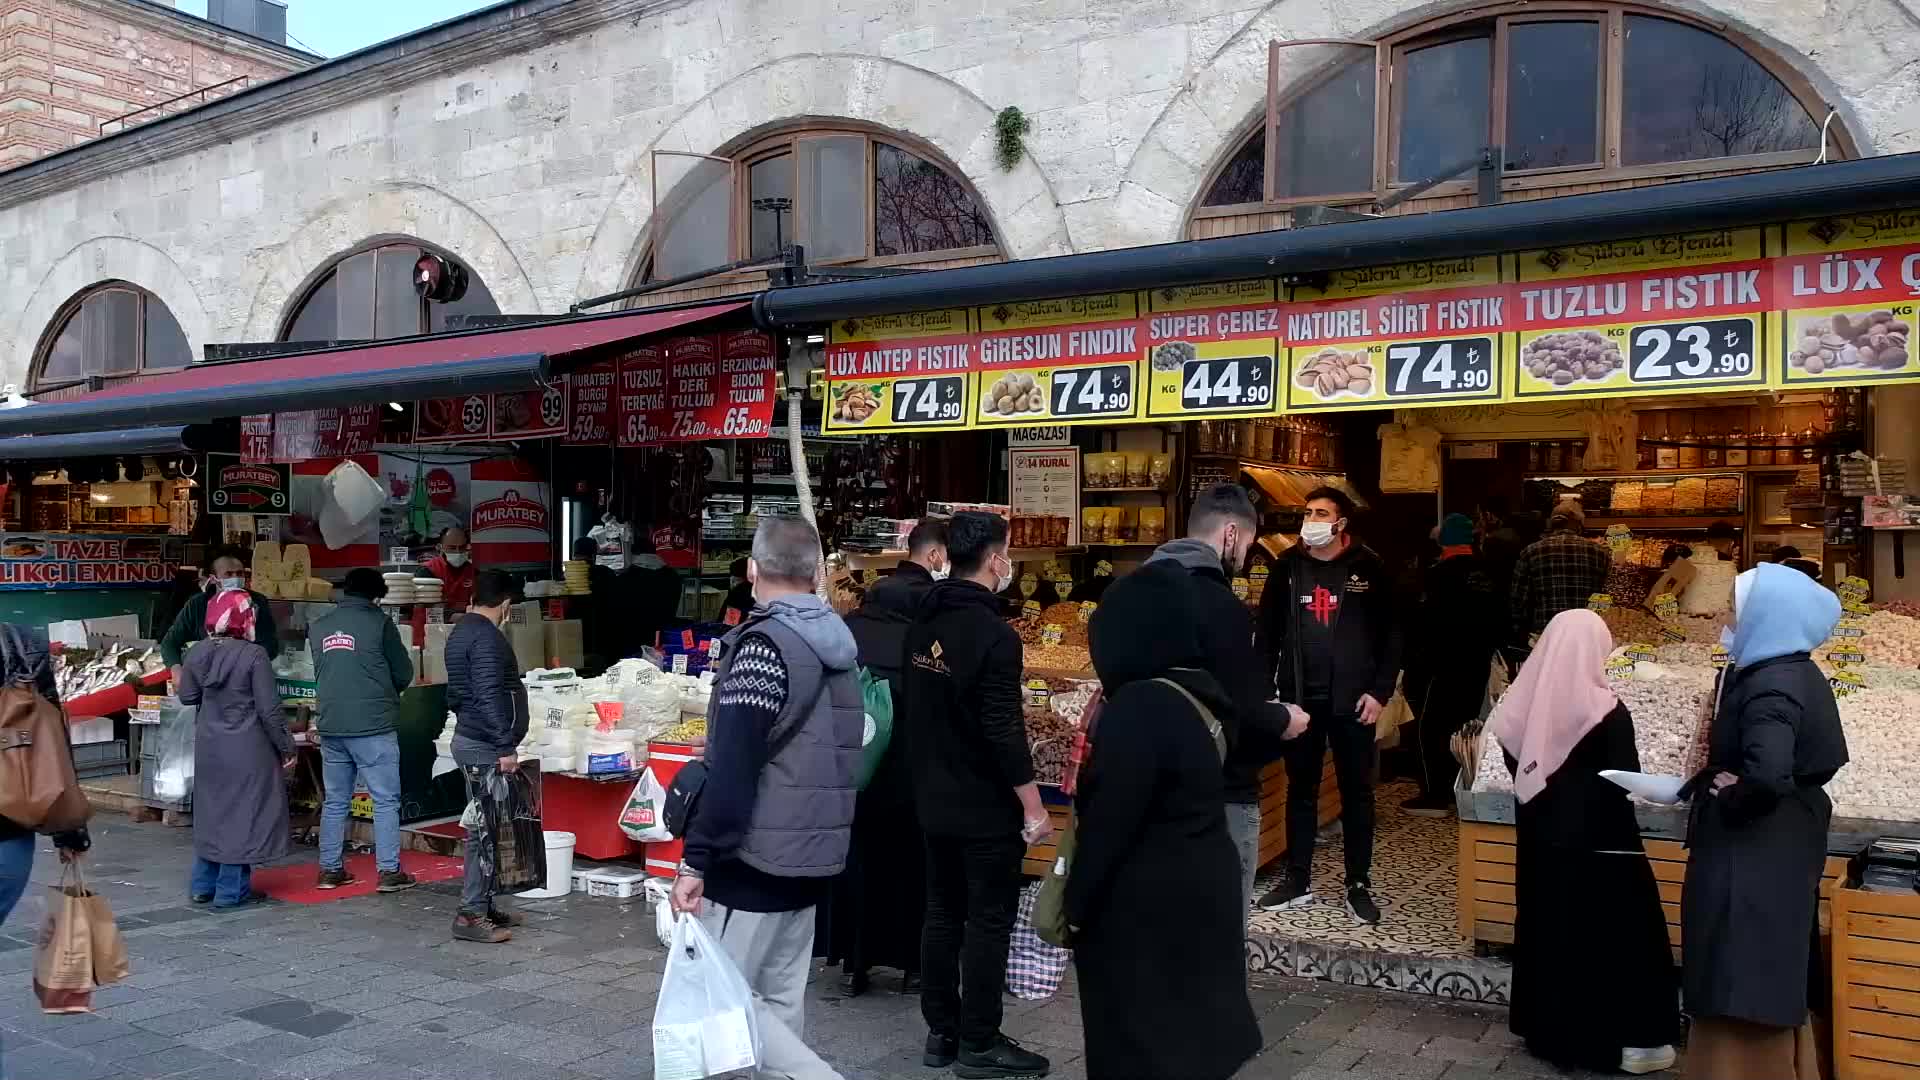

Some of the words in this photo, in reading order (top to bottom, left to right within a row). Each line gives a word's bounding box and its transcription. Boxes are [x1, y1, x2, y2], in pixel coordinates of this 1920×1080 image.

[1792, 252, 1884, 297] LÜX
[1520, 282, 1628, 322] TUZLU
[1640, 268, 1761, 312] FISTIK
[1288, 308, 1373, 342] NATUREL
[1437, 296, 1504, 331] FISTIK
[1892, 306, 1913, 316] KG
[1150, 313, 1210, 340] SÜPER
[1216, 308, 1279, 340] ÇEREZ
[1607, 328, 1625, 337] KG
[1068, 326, 1137, 357] FINDIK
[1367, 345, 1382, 353] KG
[829, 347, 858, 376] LÜX
[861, 348, 913, 374] ANTEP
[917, 343, 969, 371] FISTIK
[622, 369, 663, 389] TUZSUZ
[1161, 384, 1176, 394] KG
[672, 393, 715, 408] TULUM
[729, 388, 765, 404] TULUM
[463, 404, 485, 426] 59
[543, 395, 562, 419] 99
[1039, 457, 1071, 468] KURAL
[223, 470, 277, 483] MURATBEY
[476, 506, 545, 525] MURATBEY
[51, 539, 120, 561] TAZE
